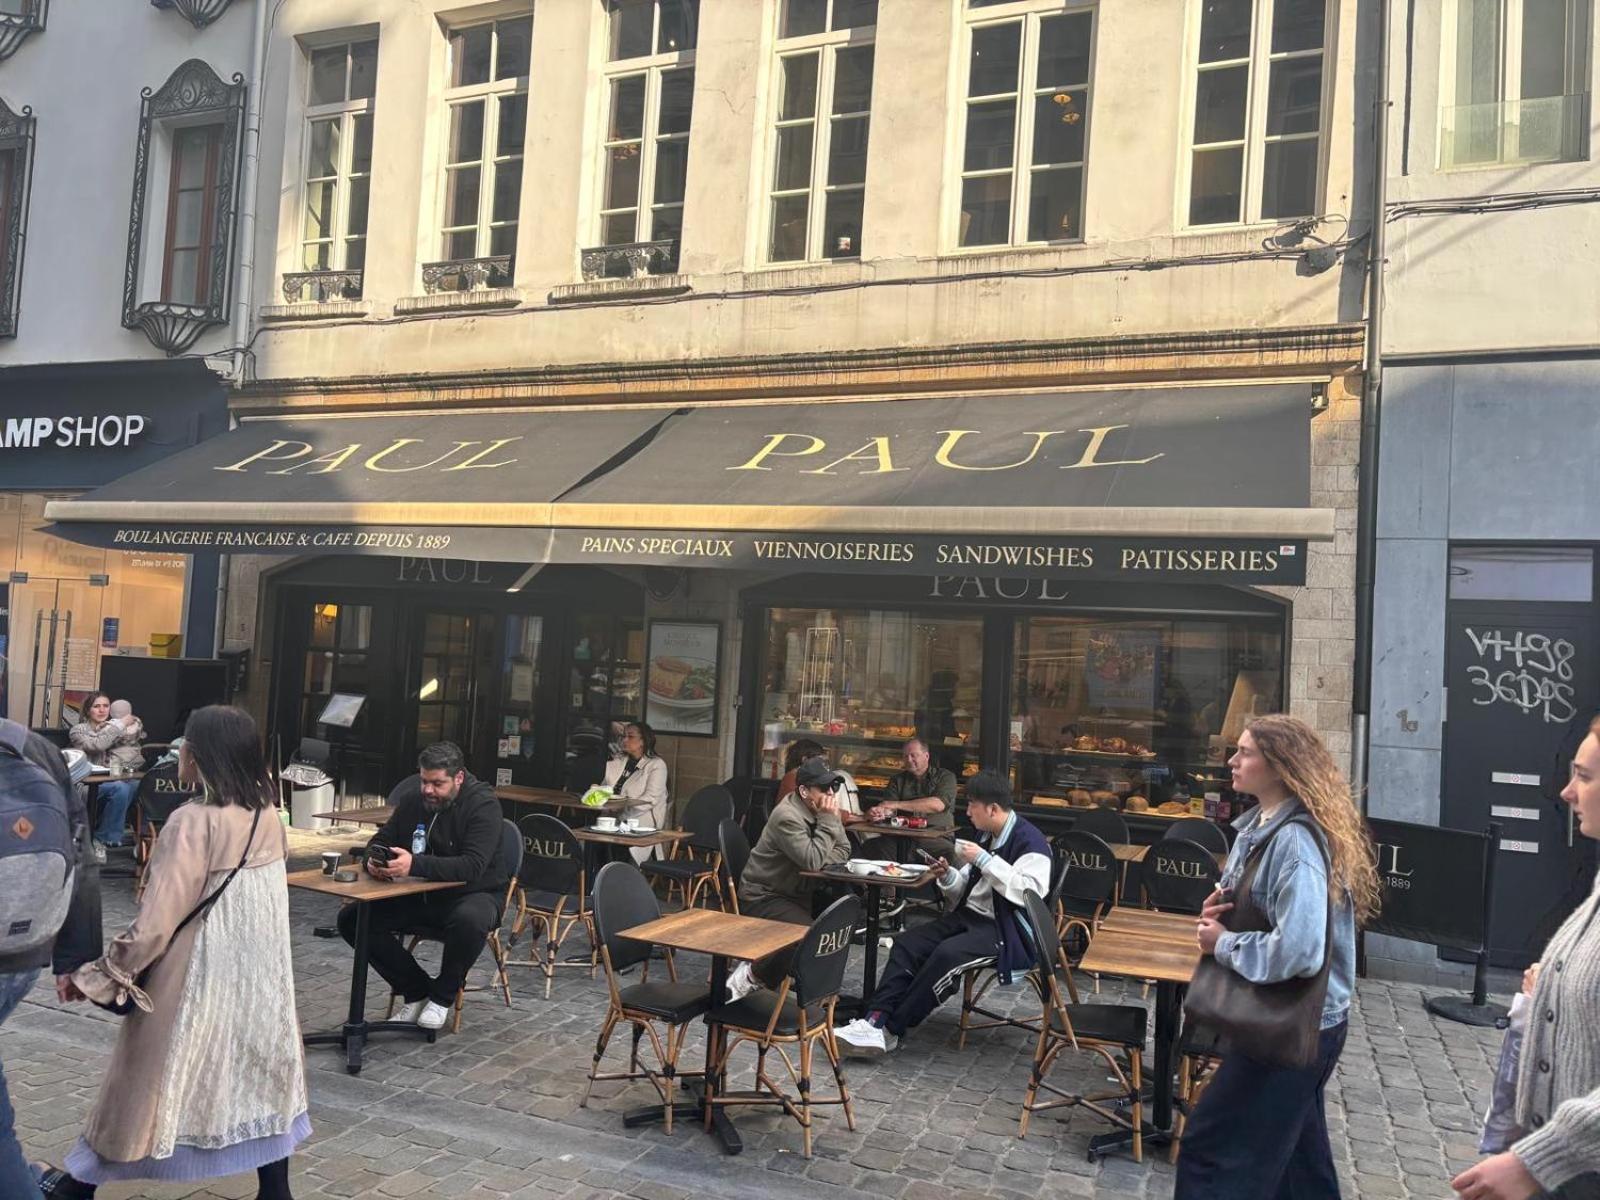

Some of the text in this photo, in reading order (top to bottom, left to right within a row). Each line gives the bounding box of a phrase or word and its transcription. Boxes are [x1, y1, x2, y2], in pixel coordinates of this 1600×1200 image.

[213, 436, 524, 475] PAUL
[726, 424, 1165, 475] PAUL
[113, 529, 451, 550] BOULANGERIE FRANCAISE & CAFE DEPUIS 1889
[581, 537, 734, 557] PAINS SPECIAUX
[754, 540, 914, 562] VIENNOISERIES
[936, 544, 1094, 568] SANDWISHES
[1120, 548, 1279, 572] PATISSERIES
[396, 556, 494, 584] PAUL
[523, 836, 572, 859] PAUL
[1155, 857, 1208, 879] PAUL
[1386, 876, 1411, 890] 1889
